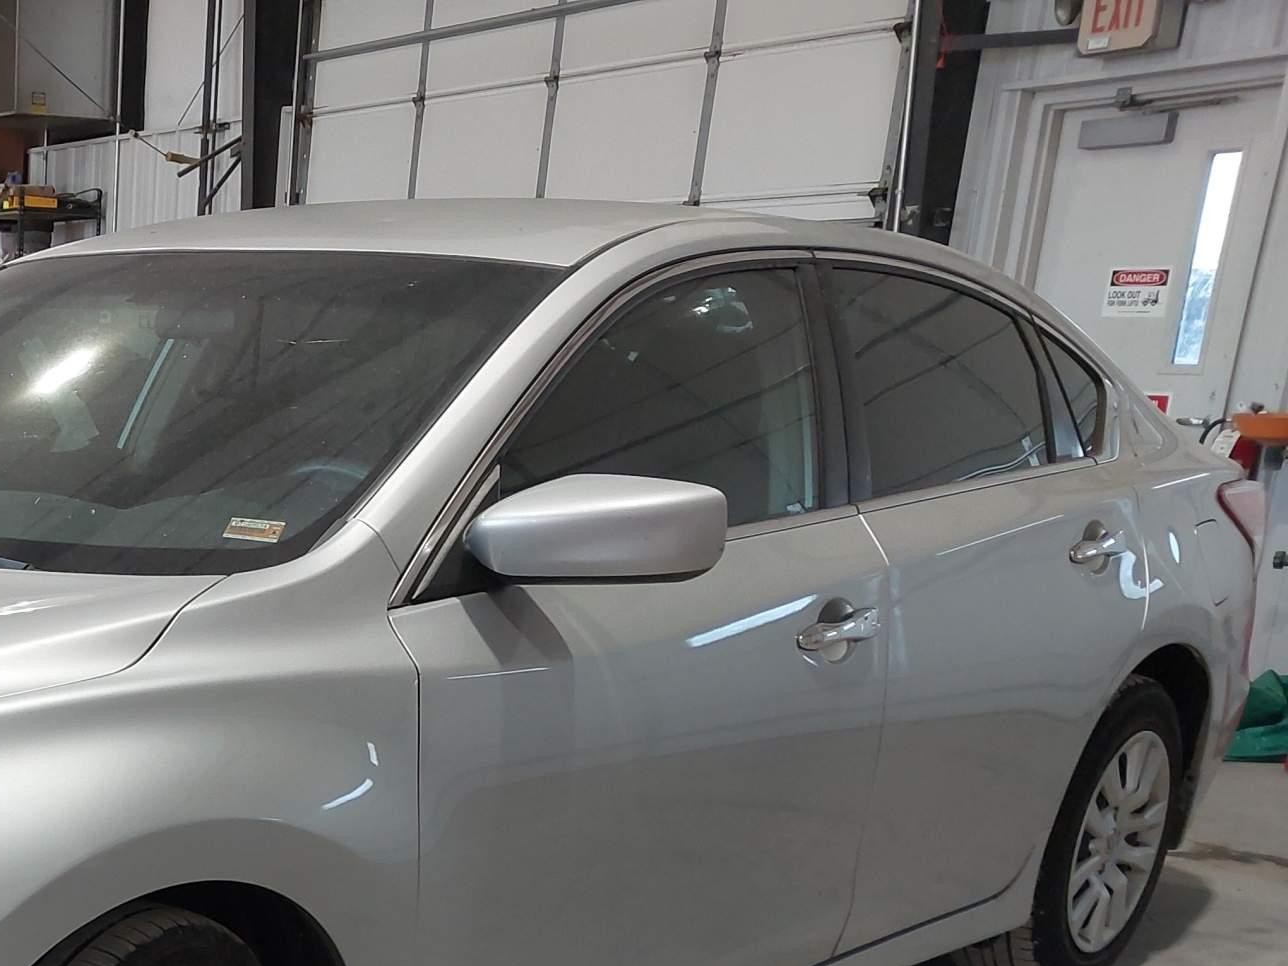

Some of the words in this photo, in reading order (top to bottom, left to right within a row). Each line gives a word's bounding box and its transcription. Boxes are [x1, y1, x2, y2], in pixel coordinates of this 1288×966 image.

[1119, 273, 1160, 283] DANGER
[1107, 290, 1126, 299] LOOK
[1127, 290, 1141, 299] OUT
